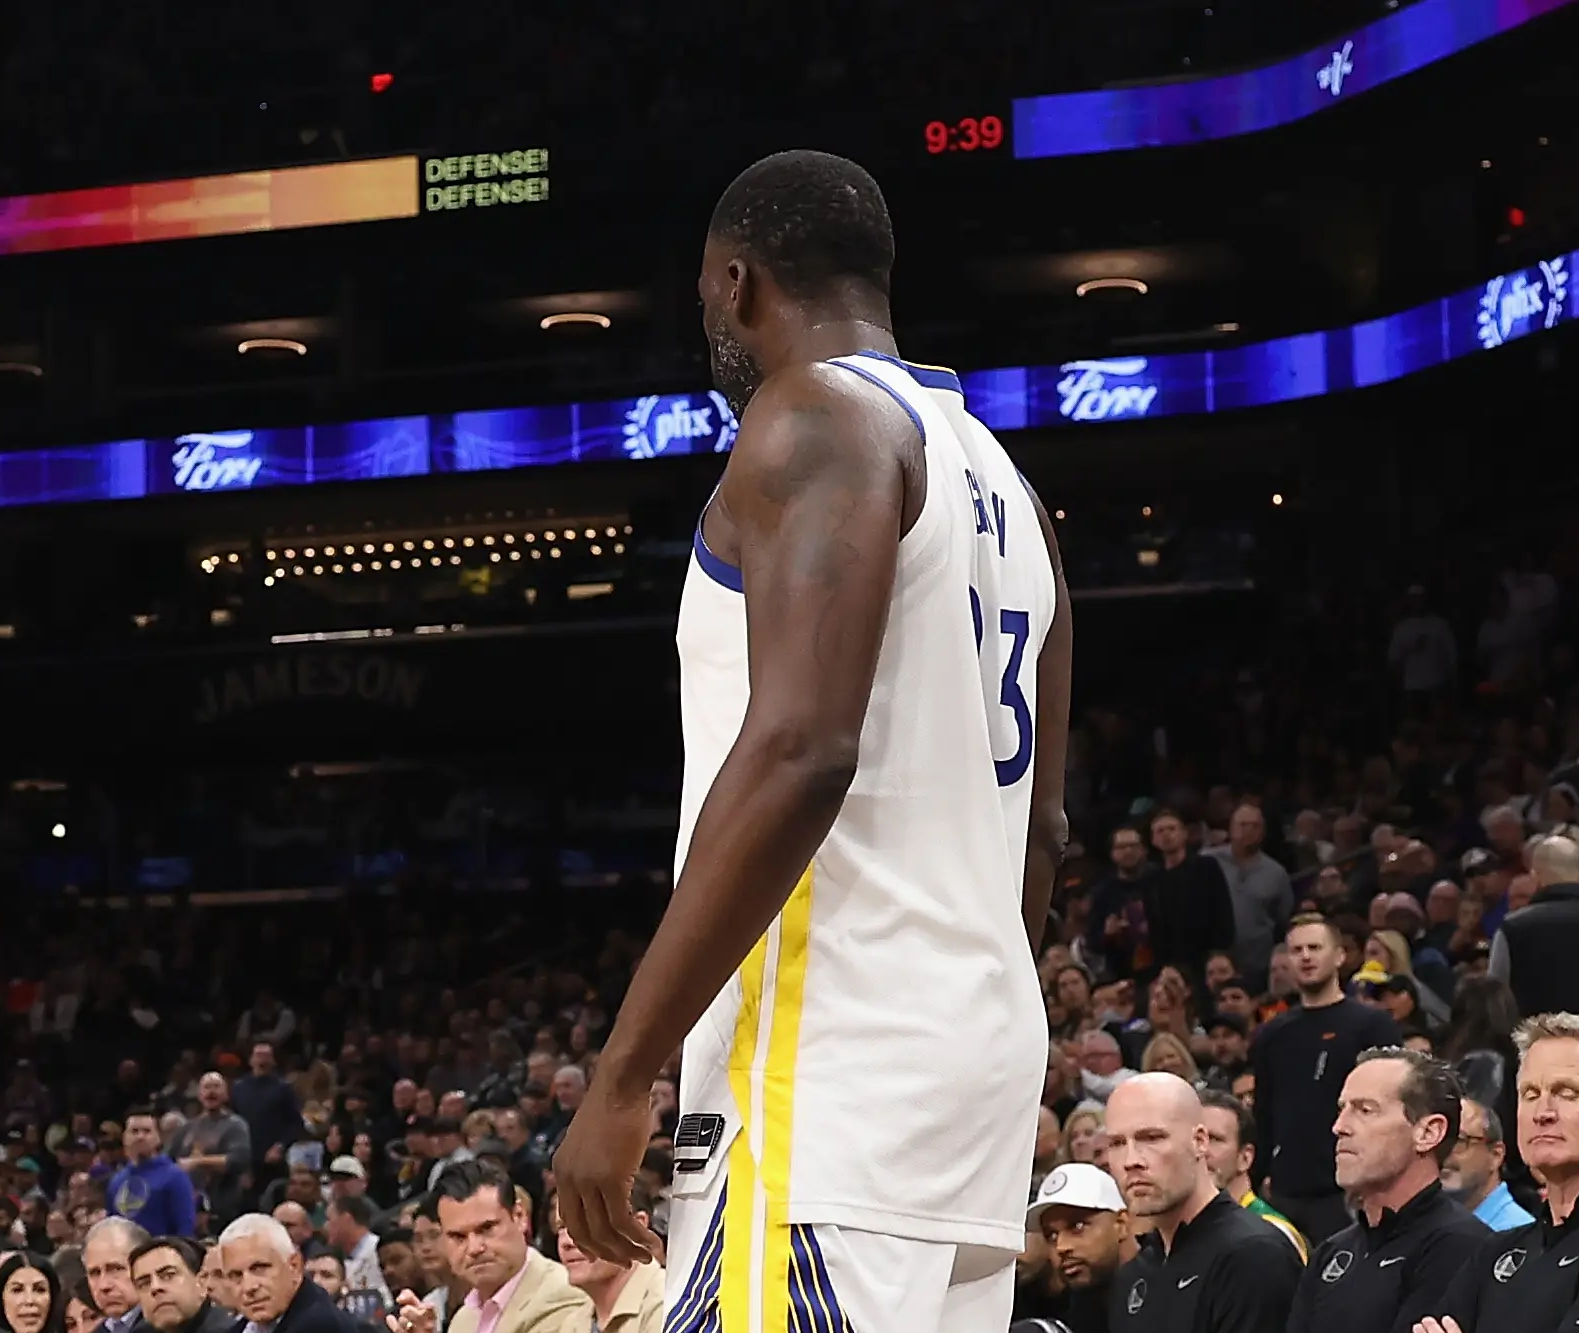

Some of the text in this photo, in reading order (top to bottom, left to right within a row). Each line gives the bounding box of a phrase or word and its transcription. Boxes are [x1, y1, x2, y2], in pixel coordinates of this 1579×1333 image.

[926, 116, 1002, 153] 9:39
[426, 149, 549, 183] DEFENSE!
[426, 178, 549, 211] DEFENSE!
[193, 652, 424, 724] JAMESON
[969, 584, 1033, 787] 3
